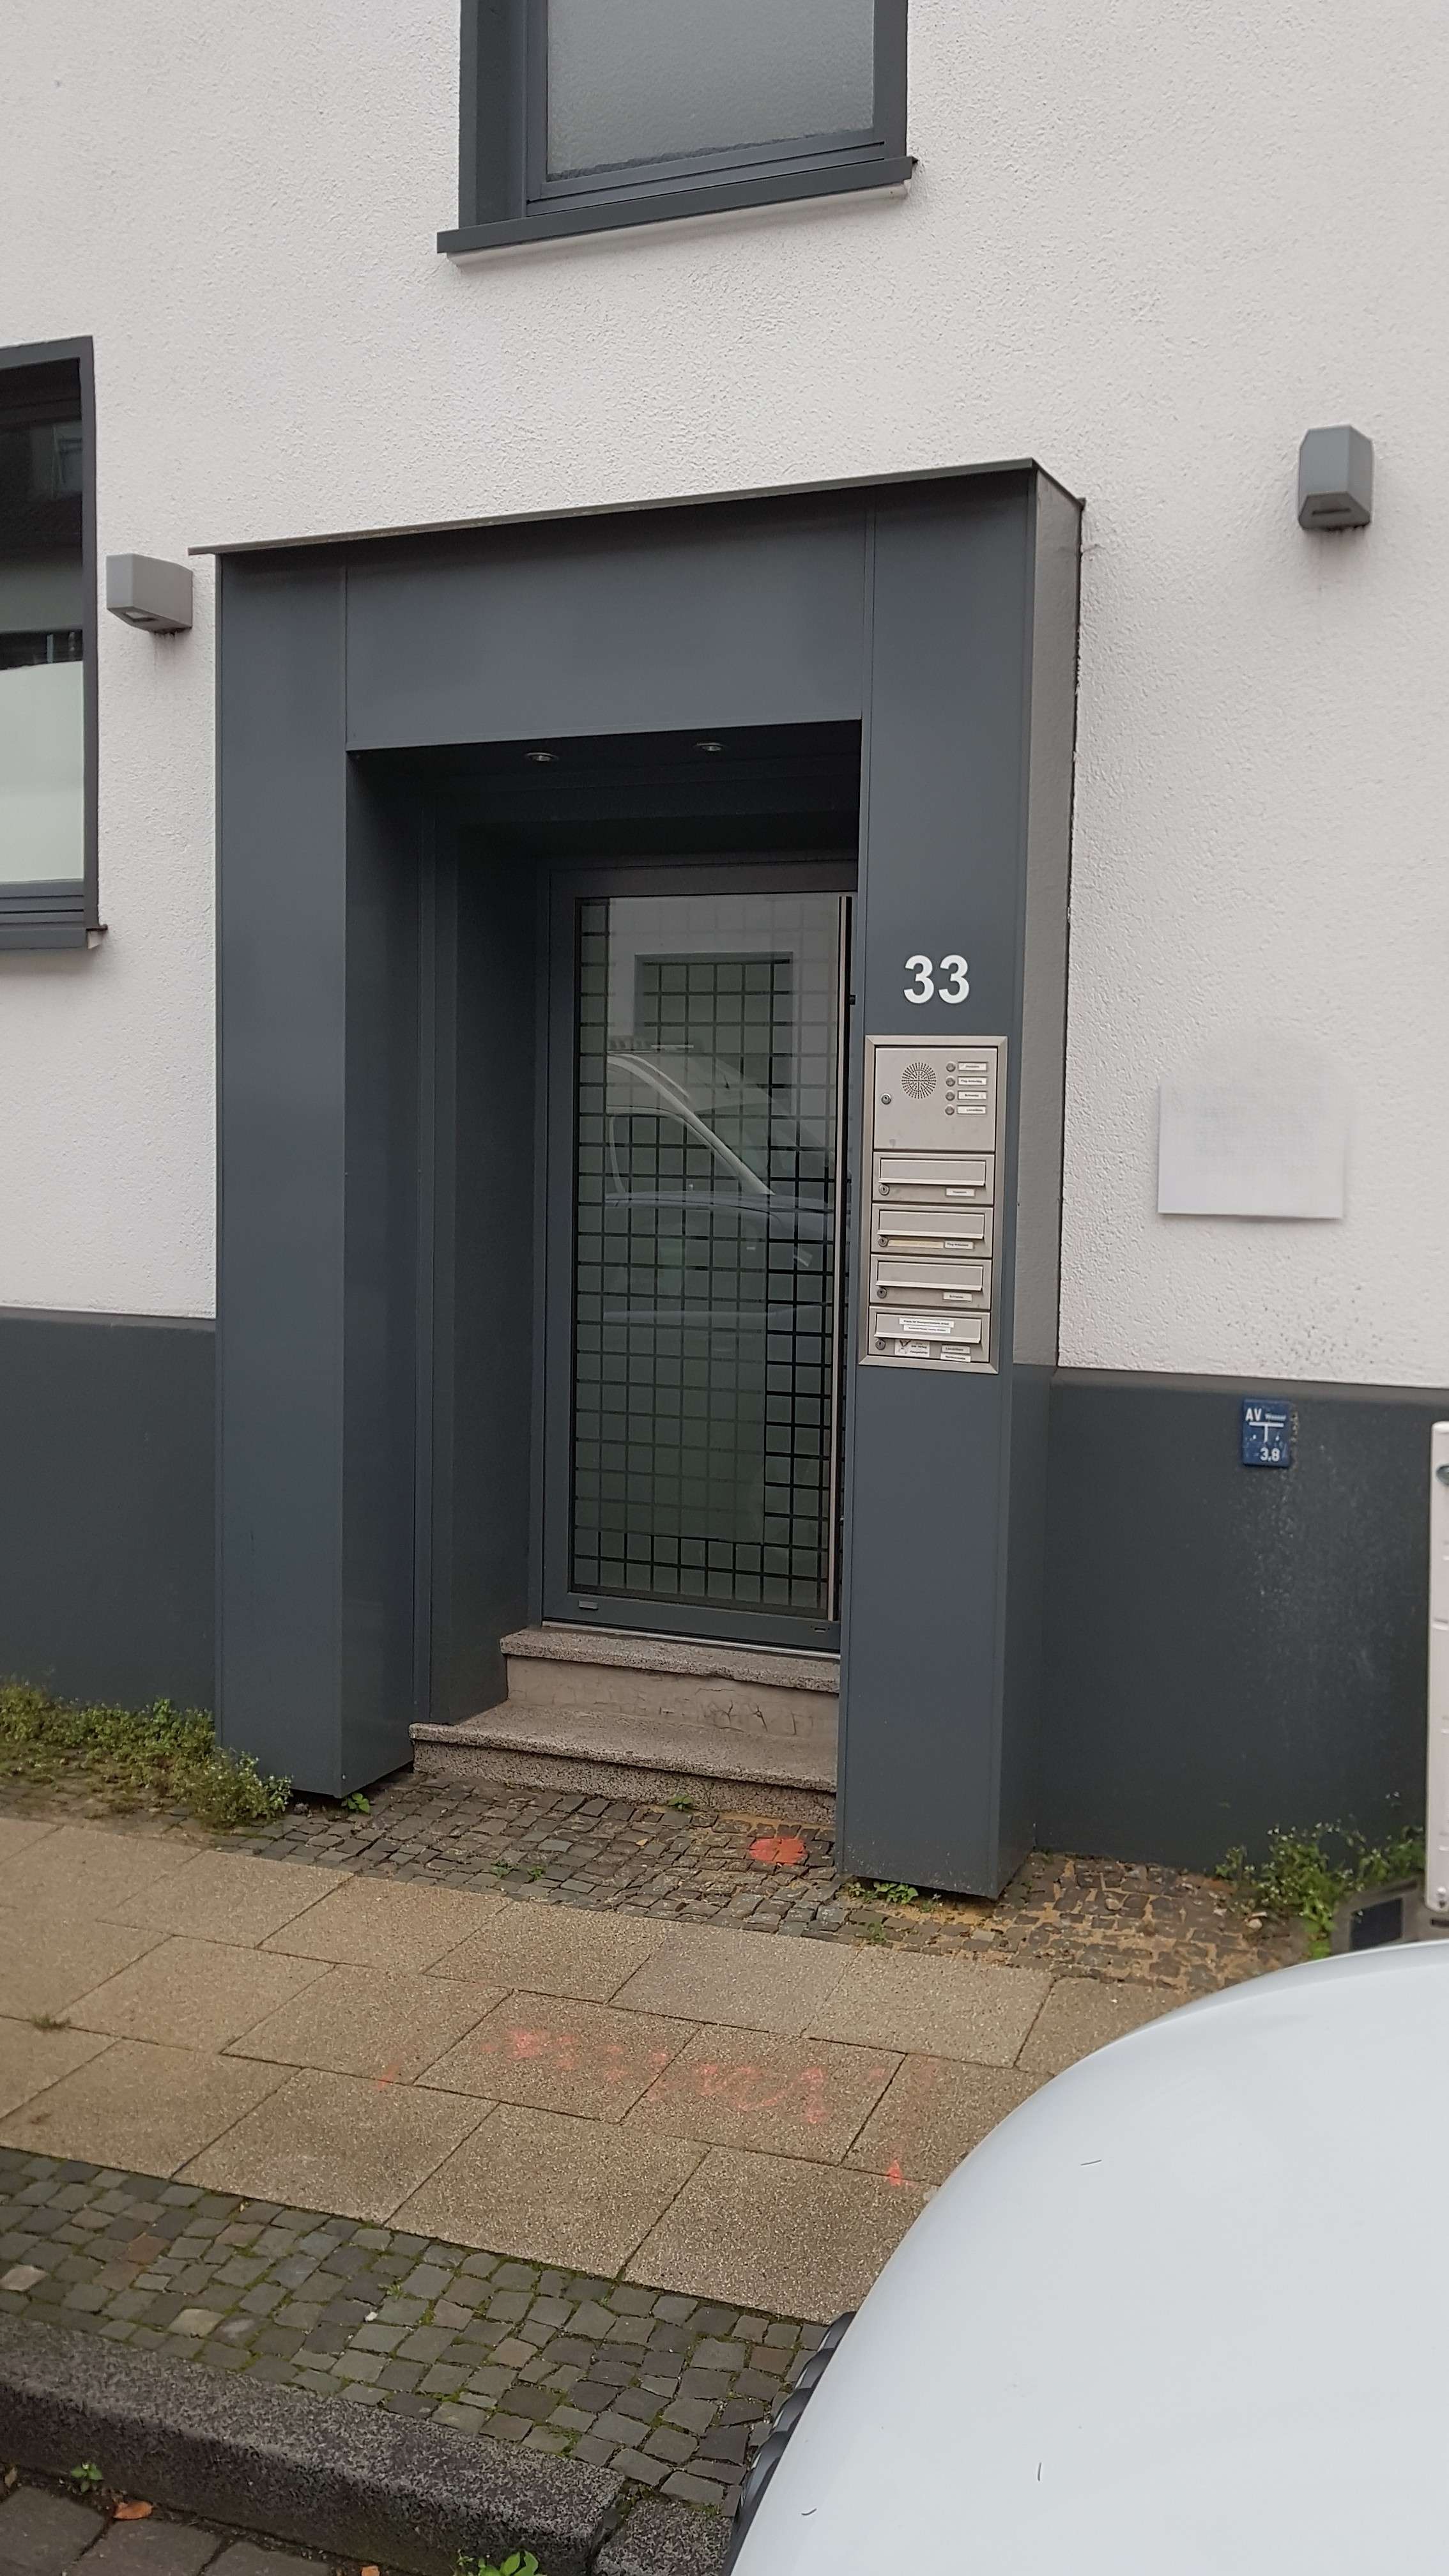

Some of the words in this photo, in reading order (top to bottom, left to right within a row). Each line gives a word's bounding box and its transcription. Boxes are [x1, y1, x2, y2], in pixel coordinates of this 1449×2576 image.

[903, 954, 970, 1004] 33
[1245, 1407, 1262, 1422] AV
[1260, 1446, 1280, 1462] 3.8
